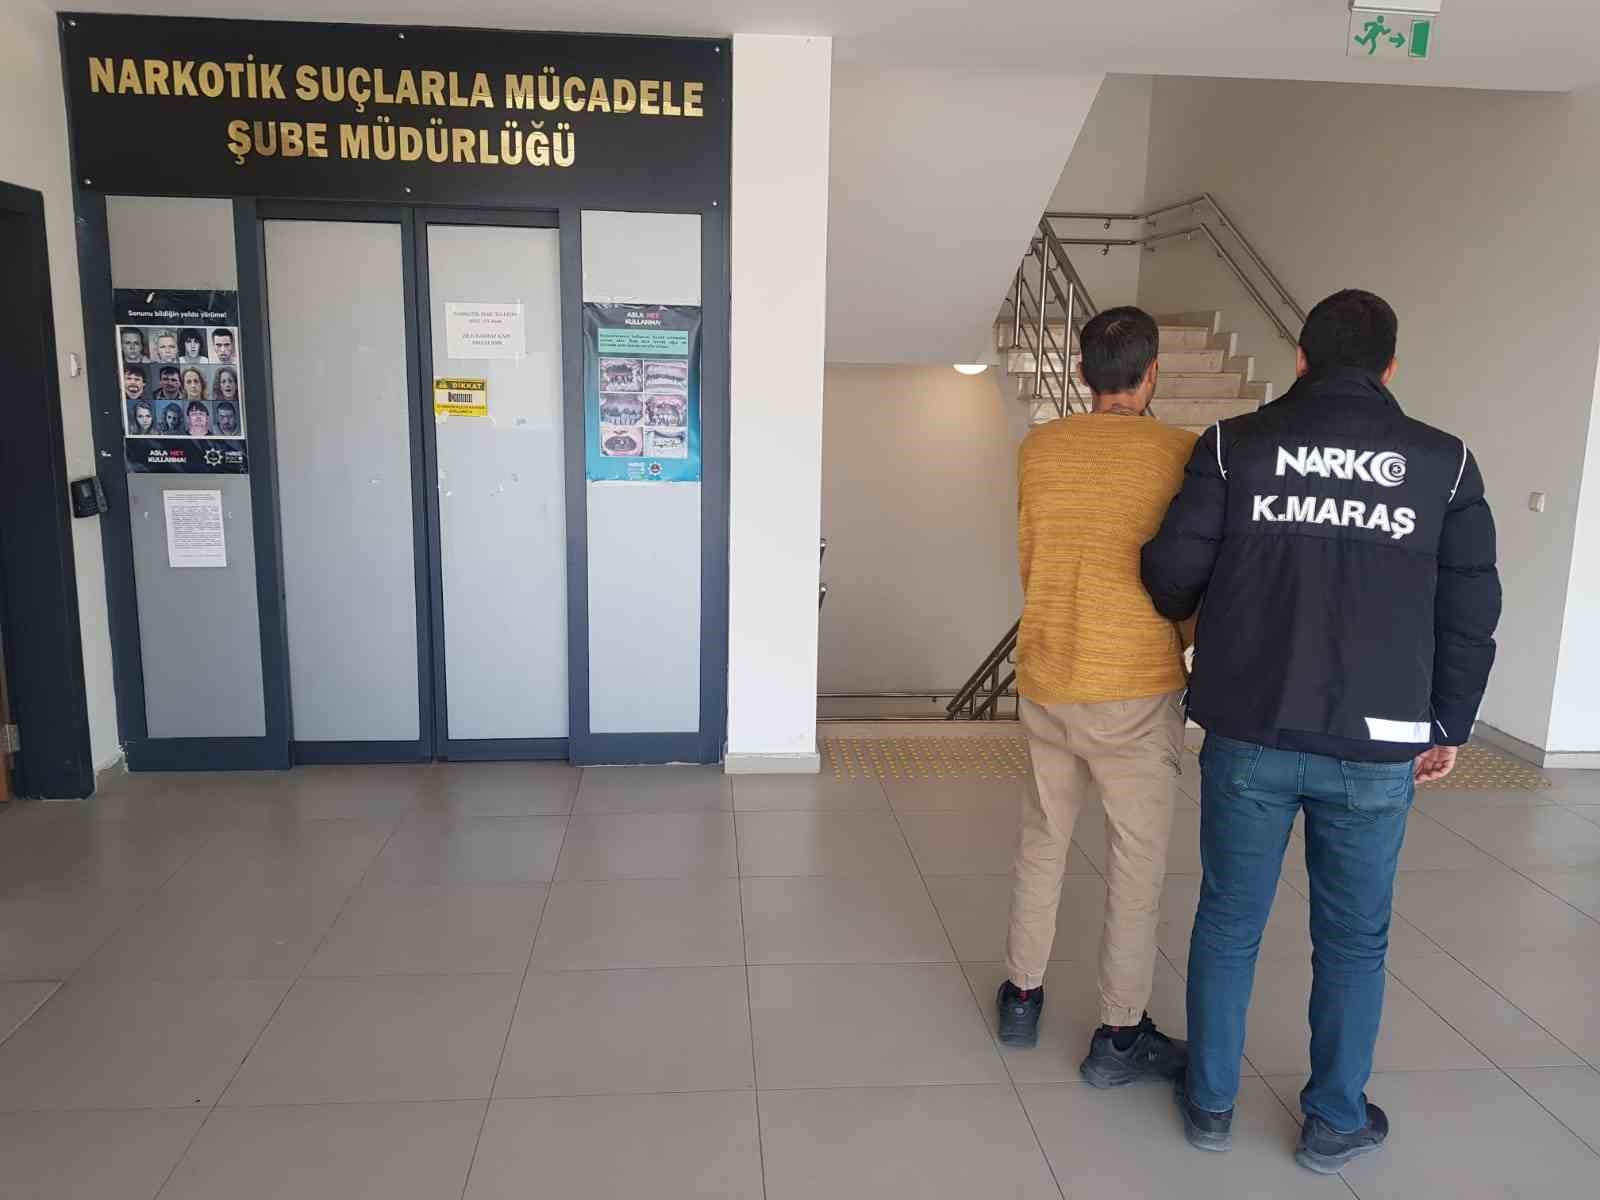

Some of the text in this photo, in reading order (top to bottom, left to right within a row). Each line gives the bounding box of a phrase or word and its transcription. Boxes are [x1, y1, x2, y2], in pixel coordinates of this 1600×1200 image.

[88, 54, 706, 118] NARKOTİK SUÇLARLA MÜCADELE
[227, 115, 577, 169] ŞUBE MÜDÜRLÜĞÜ
[1252, 494, 1417, 540] K.MARAŞ
